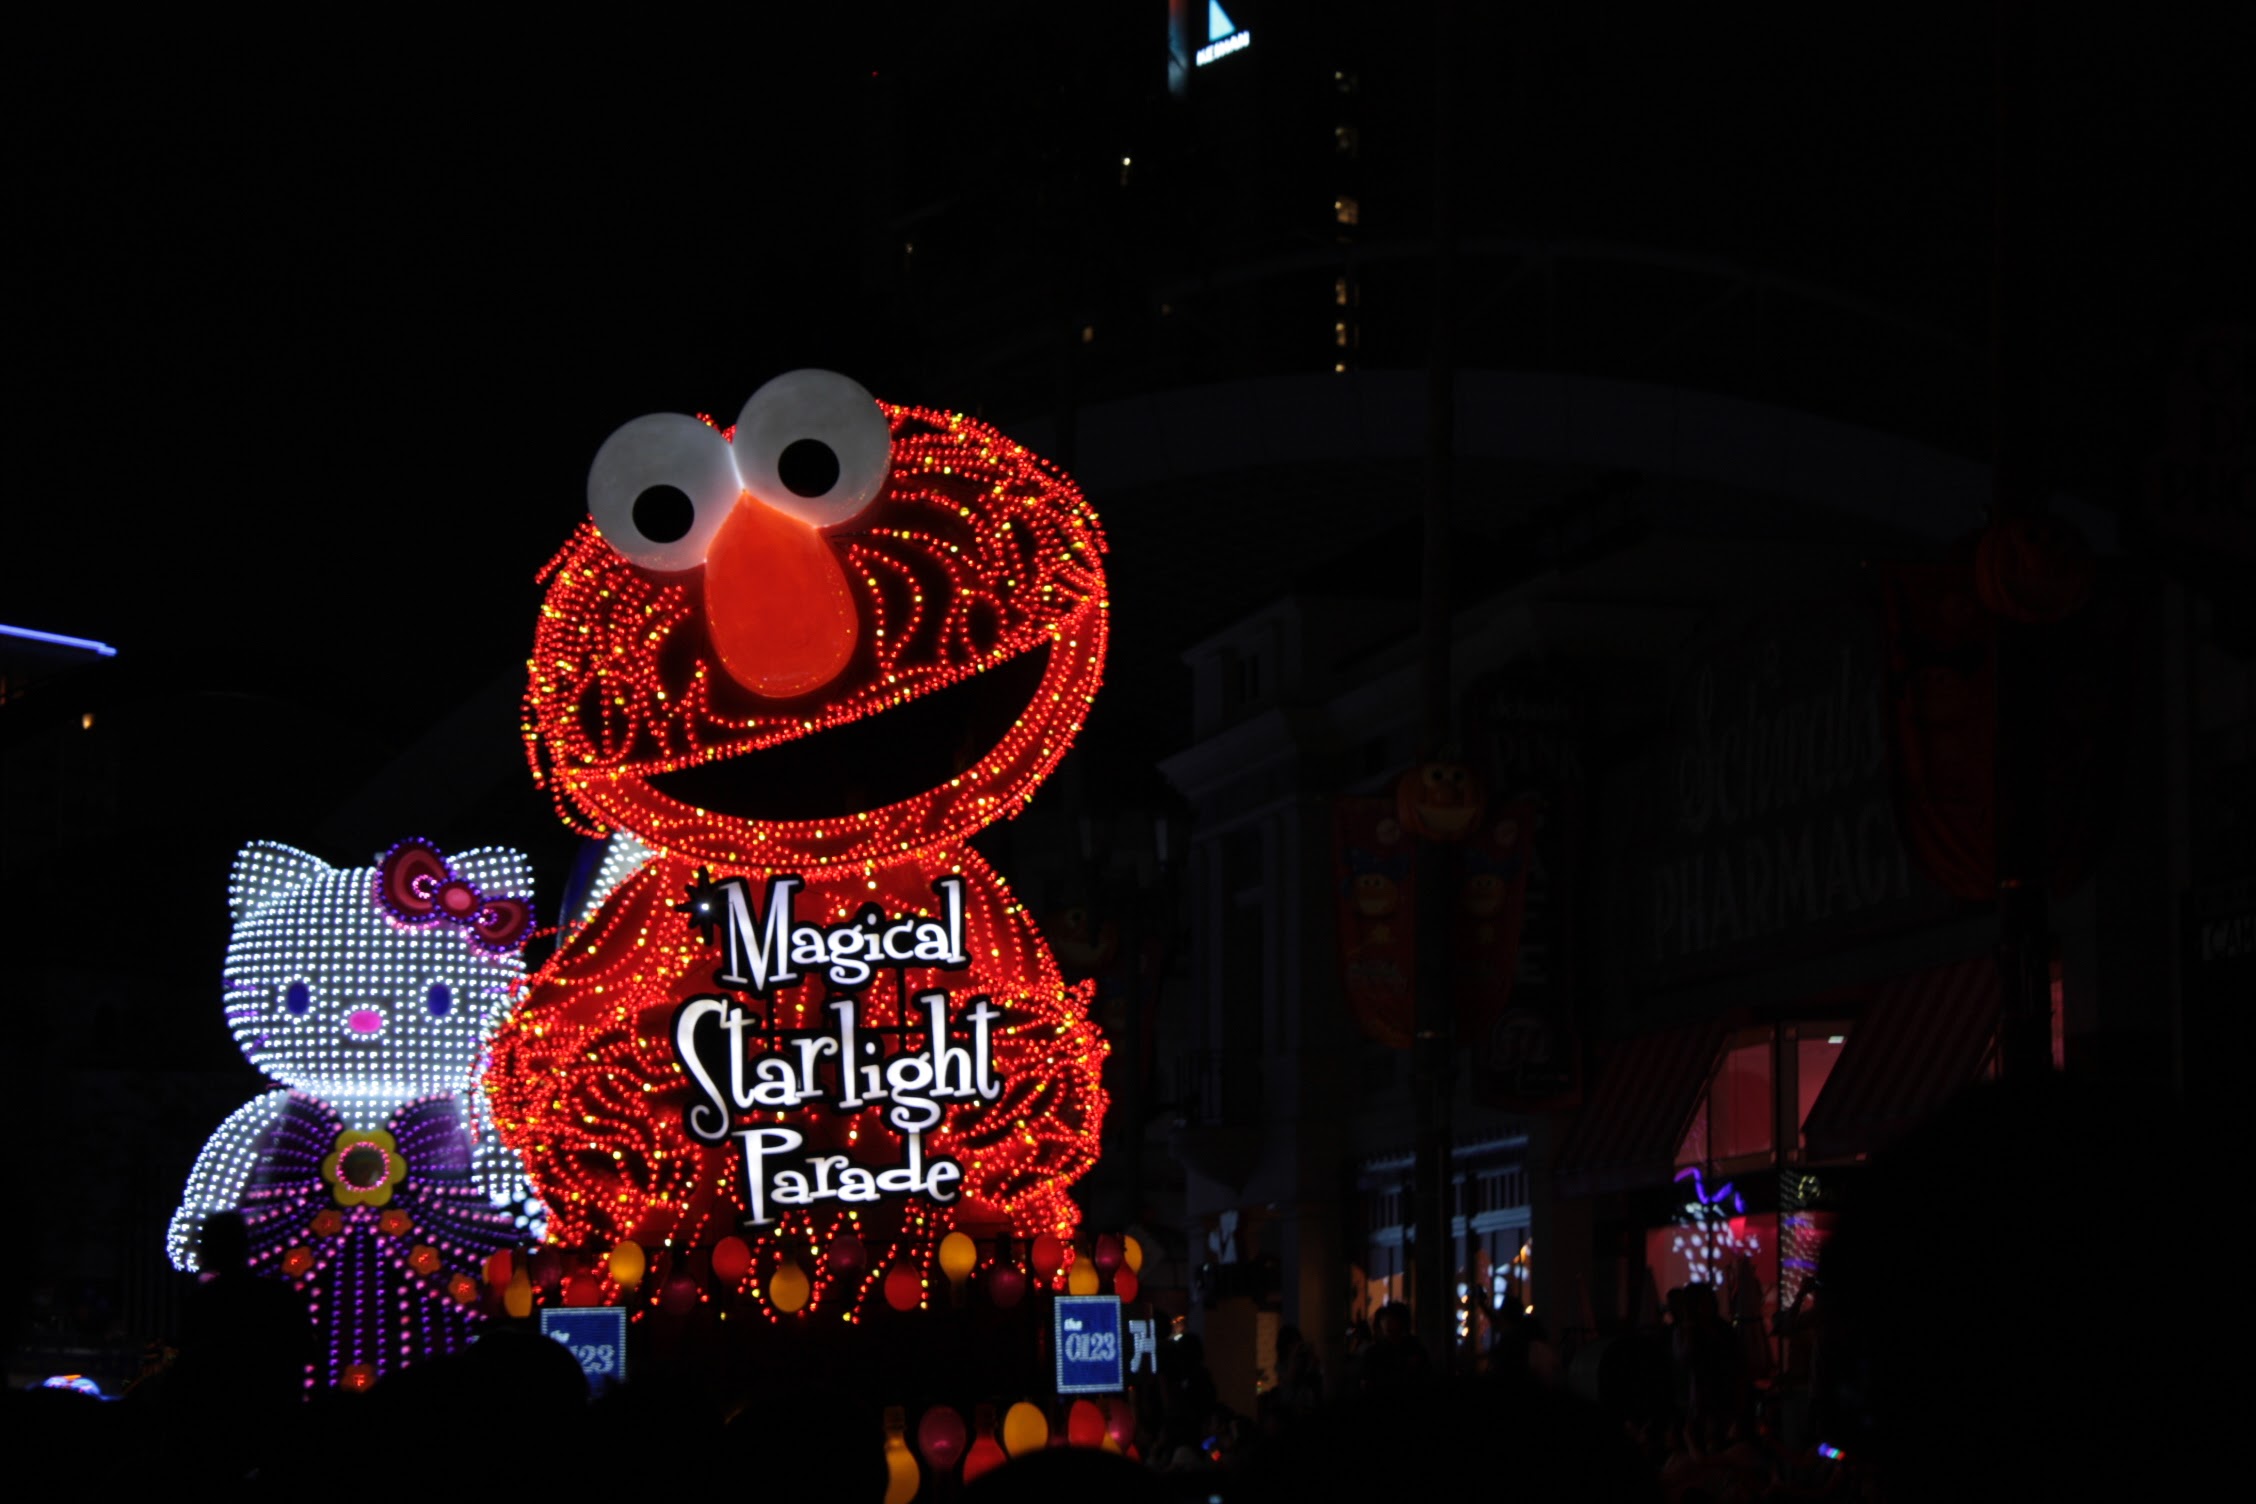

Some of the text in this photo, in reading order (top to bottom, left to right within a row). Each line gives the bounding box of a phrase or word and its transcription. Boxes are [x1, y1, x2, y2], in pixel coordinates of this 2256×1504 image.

[718, 878, 967, 991] Magical
[676, 993, 1001, 1140] Starlight
[731, 1127, 961, 1226] Parade
